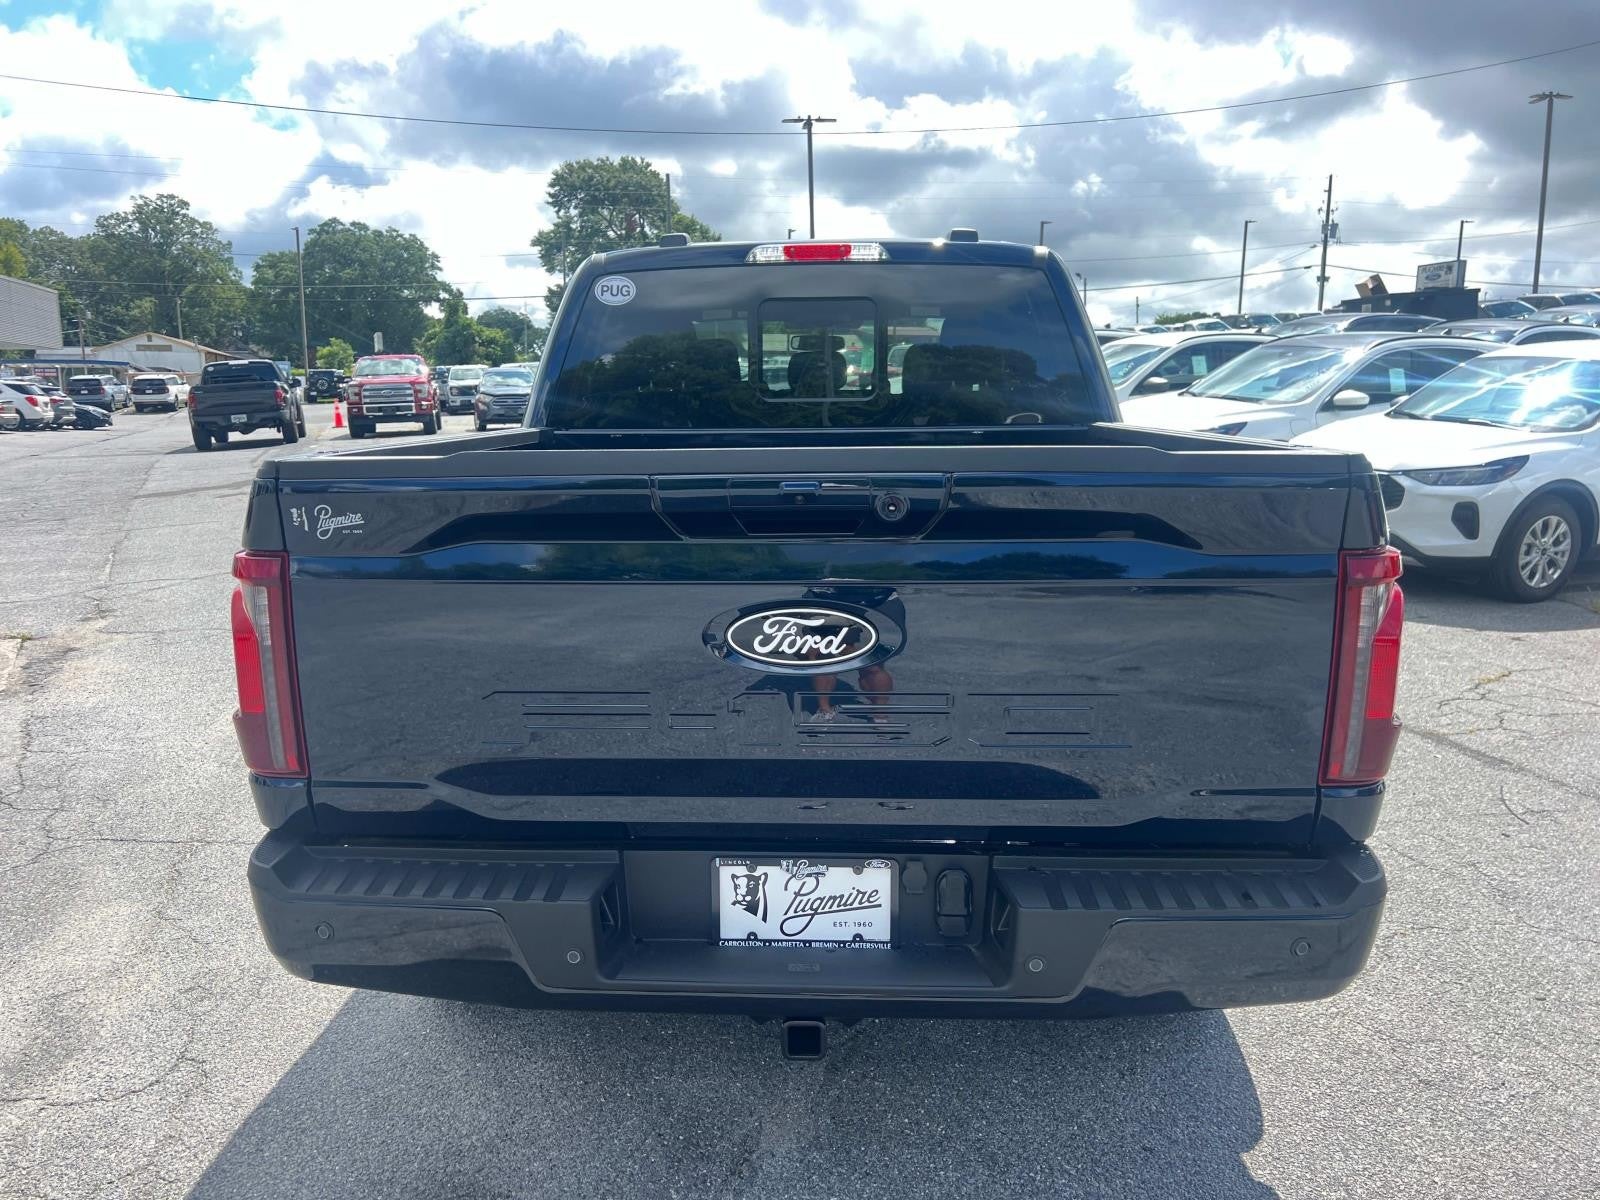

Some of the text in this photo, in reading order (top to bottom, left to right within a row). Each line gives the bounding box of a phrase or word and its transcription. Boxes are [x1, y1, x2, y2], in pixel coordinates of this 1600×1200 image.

[600, 284, 631, 297] PUG
[314, 504, 365, 540] Pugmire
[753, 616, 849, 654] Ford
[779, 872, 882, 937] Pugmire
[845, 942, 892, 950] CARTERSVILLE
